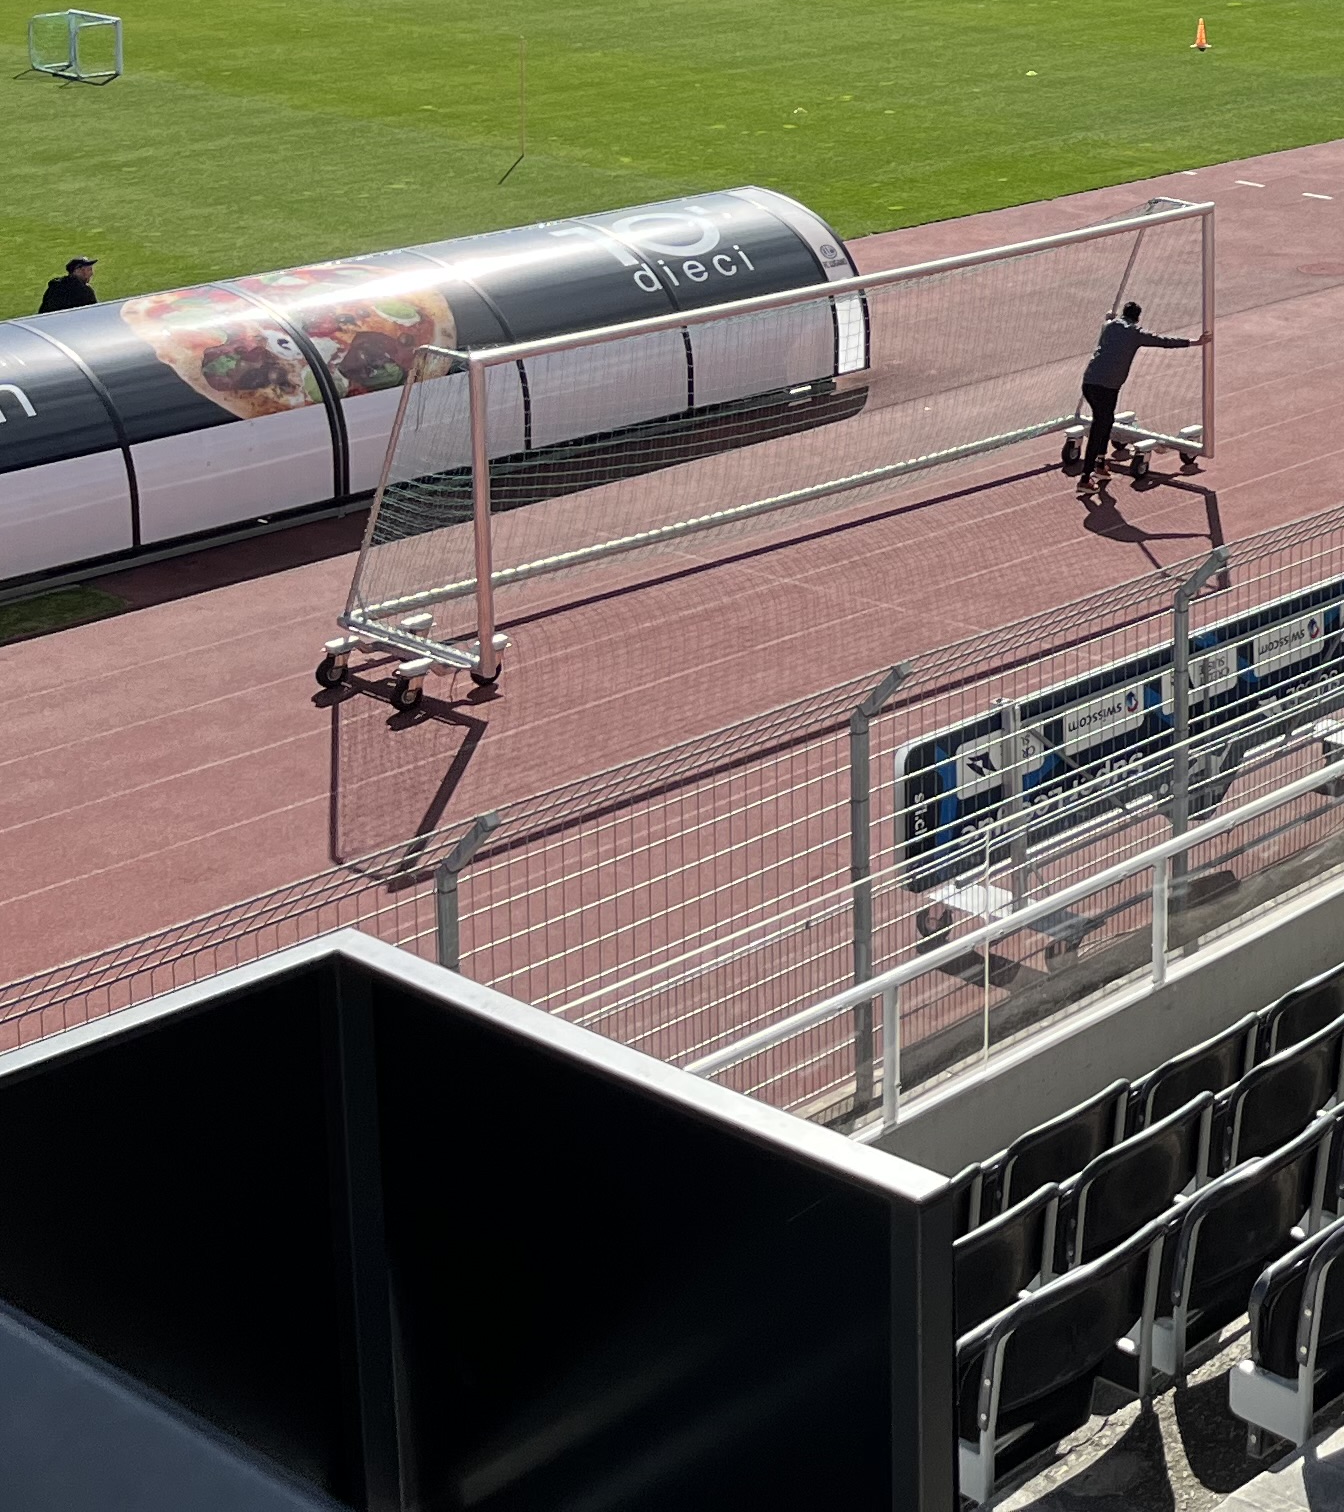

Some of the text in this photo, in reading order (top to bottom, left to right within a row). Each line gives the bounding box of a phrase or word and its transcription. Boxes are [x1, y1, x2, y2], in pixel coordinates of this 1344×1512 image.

[633, 244, 755, 293] dieci
[1258, 627, 1306, 657] swisscom
[1066, 701, 1123, 734] swisscom
[1069, 751, 1145, 801] Super
